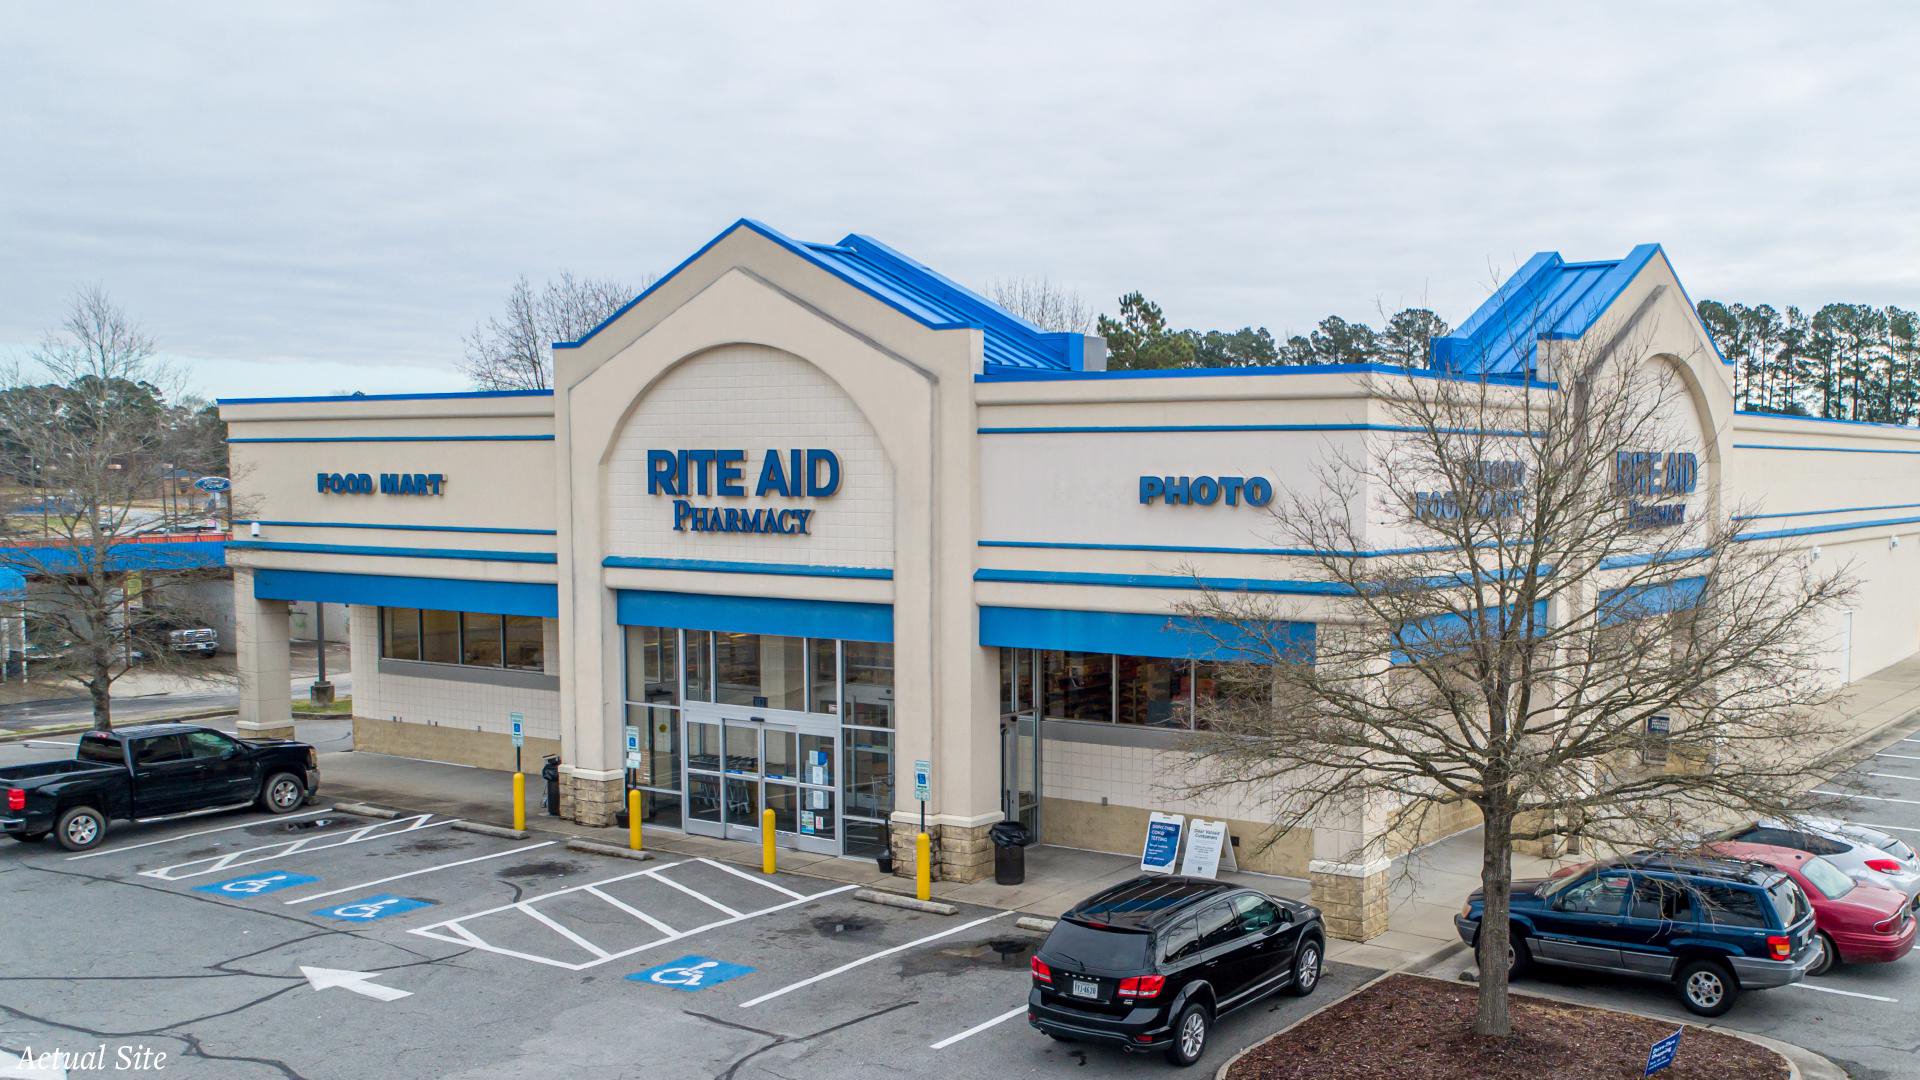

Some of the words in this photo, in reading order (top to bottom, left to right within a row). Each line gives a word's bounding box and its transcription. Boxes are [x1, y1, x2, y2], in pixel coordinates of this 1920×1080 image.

[317, 472, 373, 495] FOOD
[380, 473, 445, 496] MART
[647, 449, 746, 497] RITE
[755, 449, 841, 497] AID
[1139, 475, 1273, 507] PHOTO
[1664, 452, 1698, 496] AID
[672, 499, 813, 535] PHARMACY
